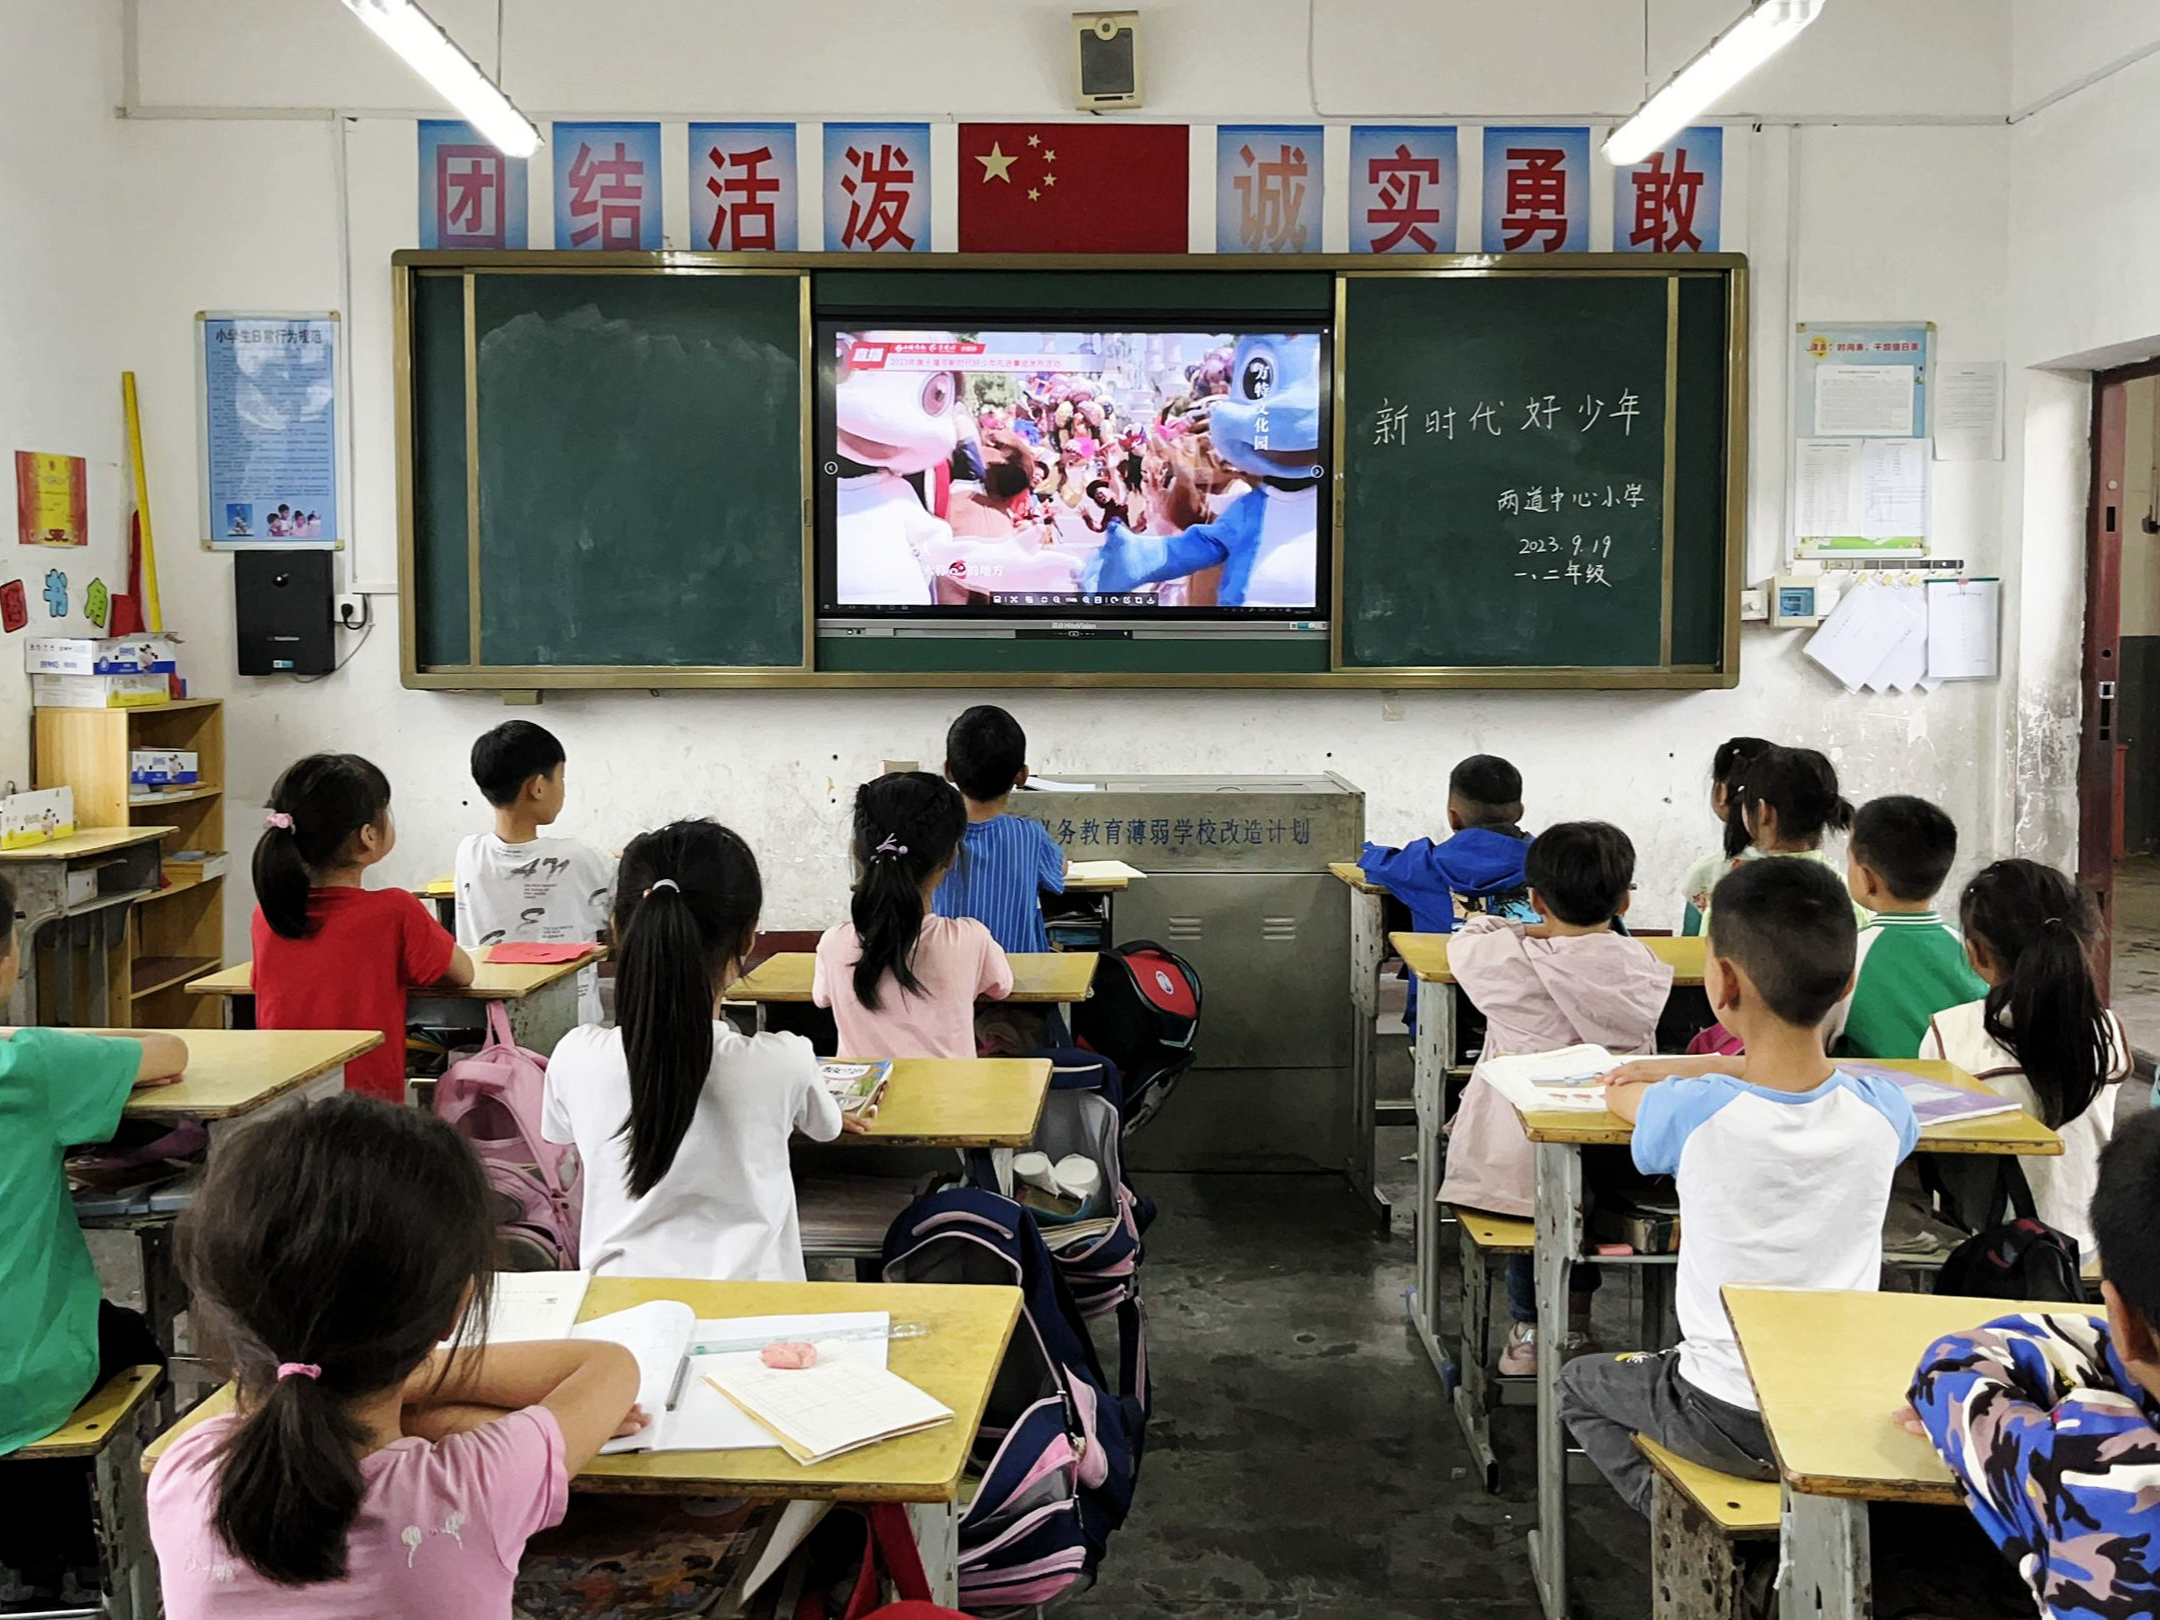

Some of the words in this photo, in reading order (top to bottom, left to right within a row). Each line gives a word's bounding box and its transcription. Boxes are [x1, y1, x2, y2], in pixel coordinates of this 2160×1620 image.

[1373, 388, 1641, 446] 新时代好少年
[1497, 483, 1644, 515] 两道中心小学
[1513, 560, 1613, 588] 一、二年级
